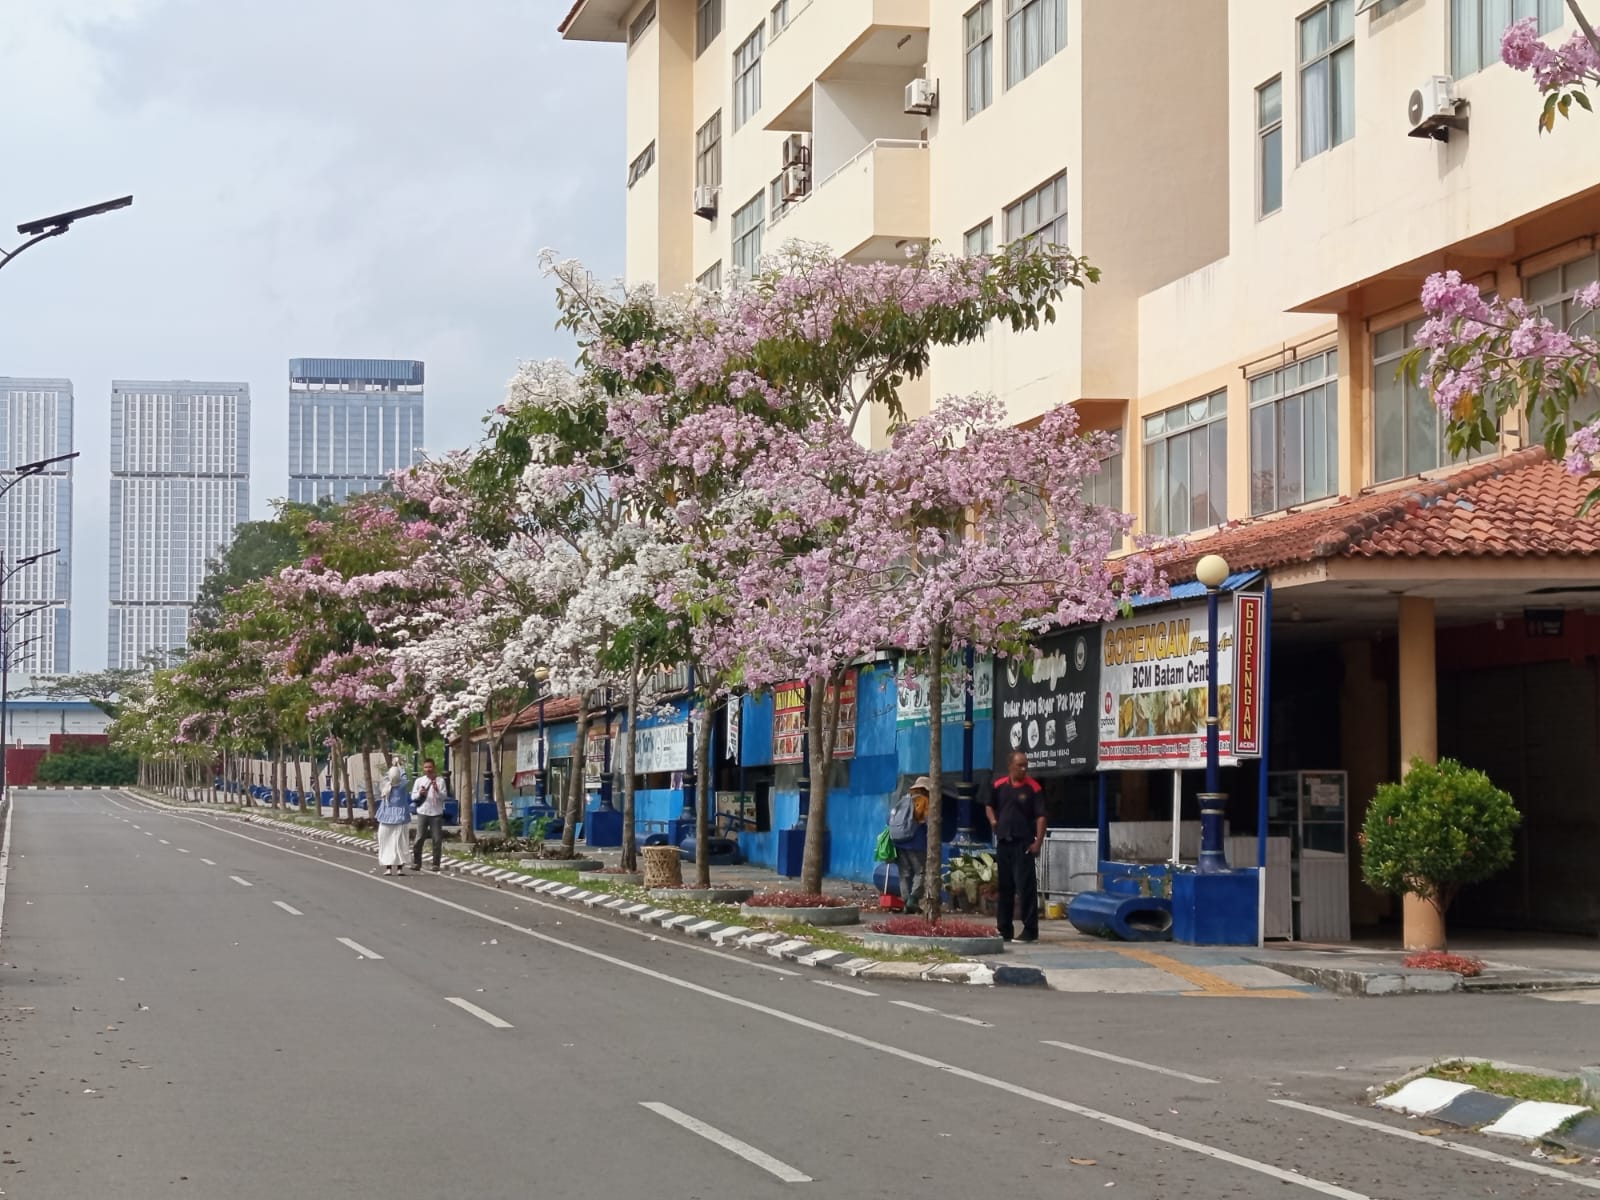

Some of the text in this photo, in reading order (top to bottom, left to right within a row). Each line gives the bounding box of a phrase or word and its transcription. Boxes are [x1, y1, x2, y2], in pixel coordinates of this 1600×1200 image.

[1104, 618, 1190, 667] GORENGAN
[1132, 665, 1151, 688] BCM
[1154, 663, 1184, 686] Batam
[1243, 602, 1254, 740] GORENGAN
